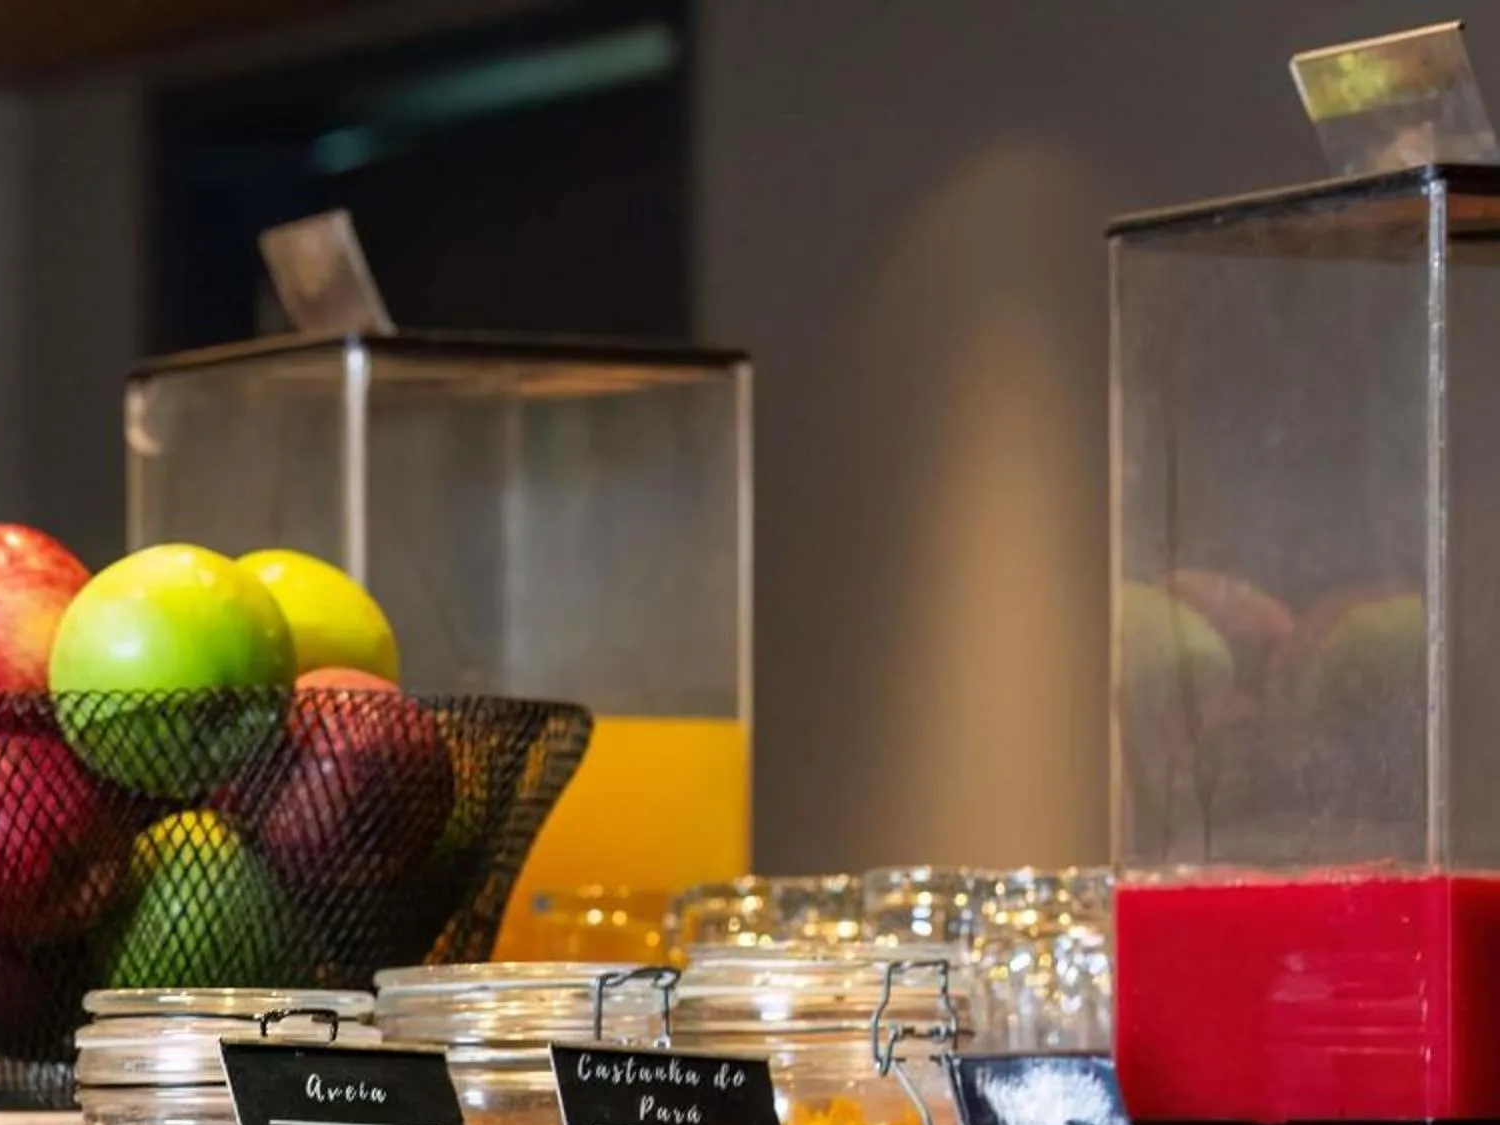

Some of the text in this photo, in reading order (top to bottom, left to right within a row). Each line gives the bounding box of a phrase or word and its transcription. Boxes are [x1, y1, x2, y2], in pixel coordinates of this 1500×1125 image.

[577, 1052, 747, 1090] Castanha do
[305, 1073, 387, 1103] Aveia
[639, 1095, 703, 1124] Pará
